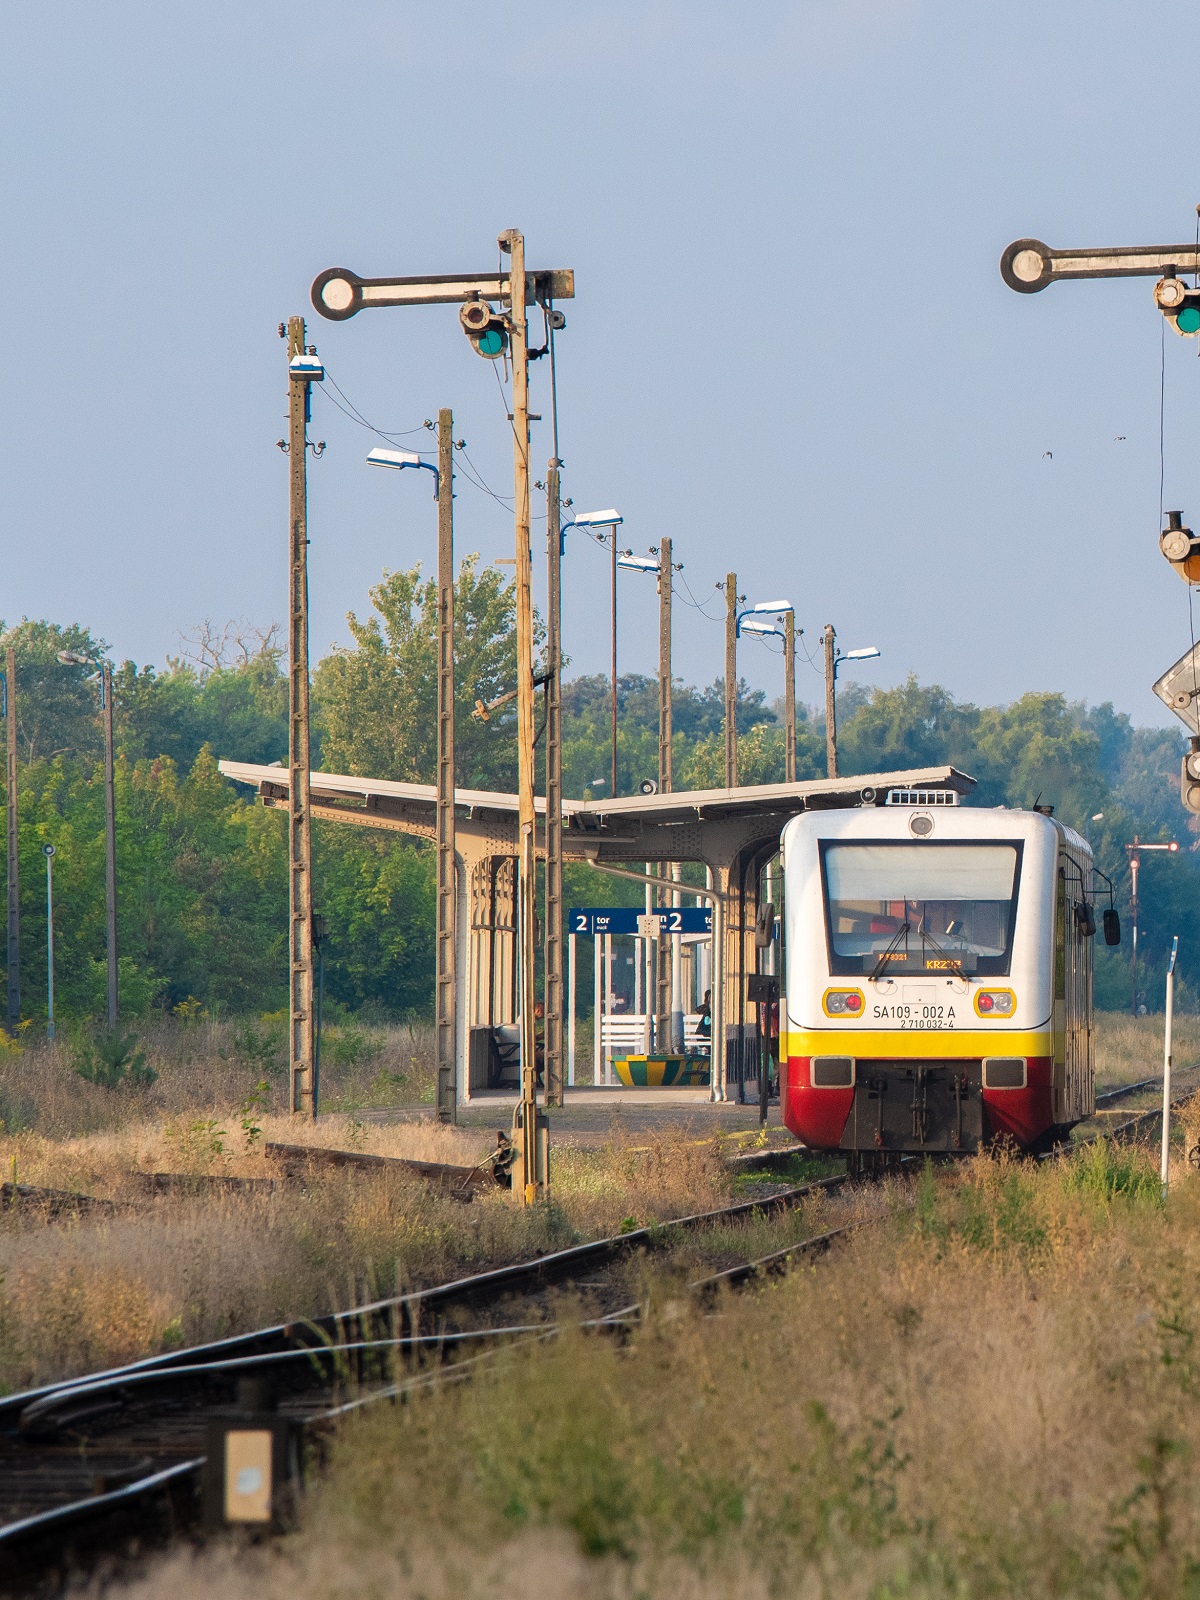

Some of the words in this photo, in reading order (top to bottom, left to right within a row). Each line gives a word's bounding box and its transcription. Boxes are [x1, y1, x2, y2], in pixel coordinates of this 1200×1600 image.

[576, 915, 587, 931] 2
[596, 916, 610, 924] tor
[669, 912, 682, 931] 2
[704, 916, 712, 924] to
[873, 1005, 911, 1019] SA109
[922, 1005, 944, 1019] 002
[947, 1005, 956, 1019] A
[900, 1020, 906, 1029] 2
[909, 1020, 924, 1029] 710
[926, 1020, 954, 1029] 032-4
